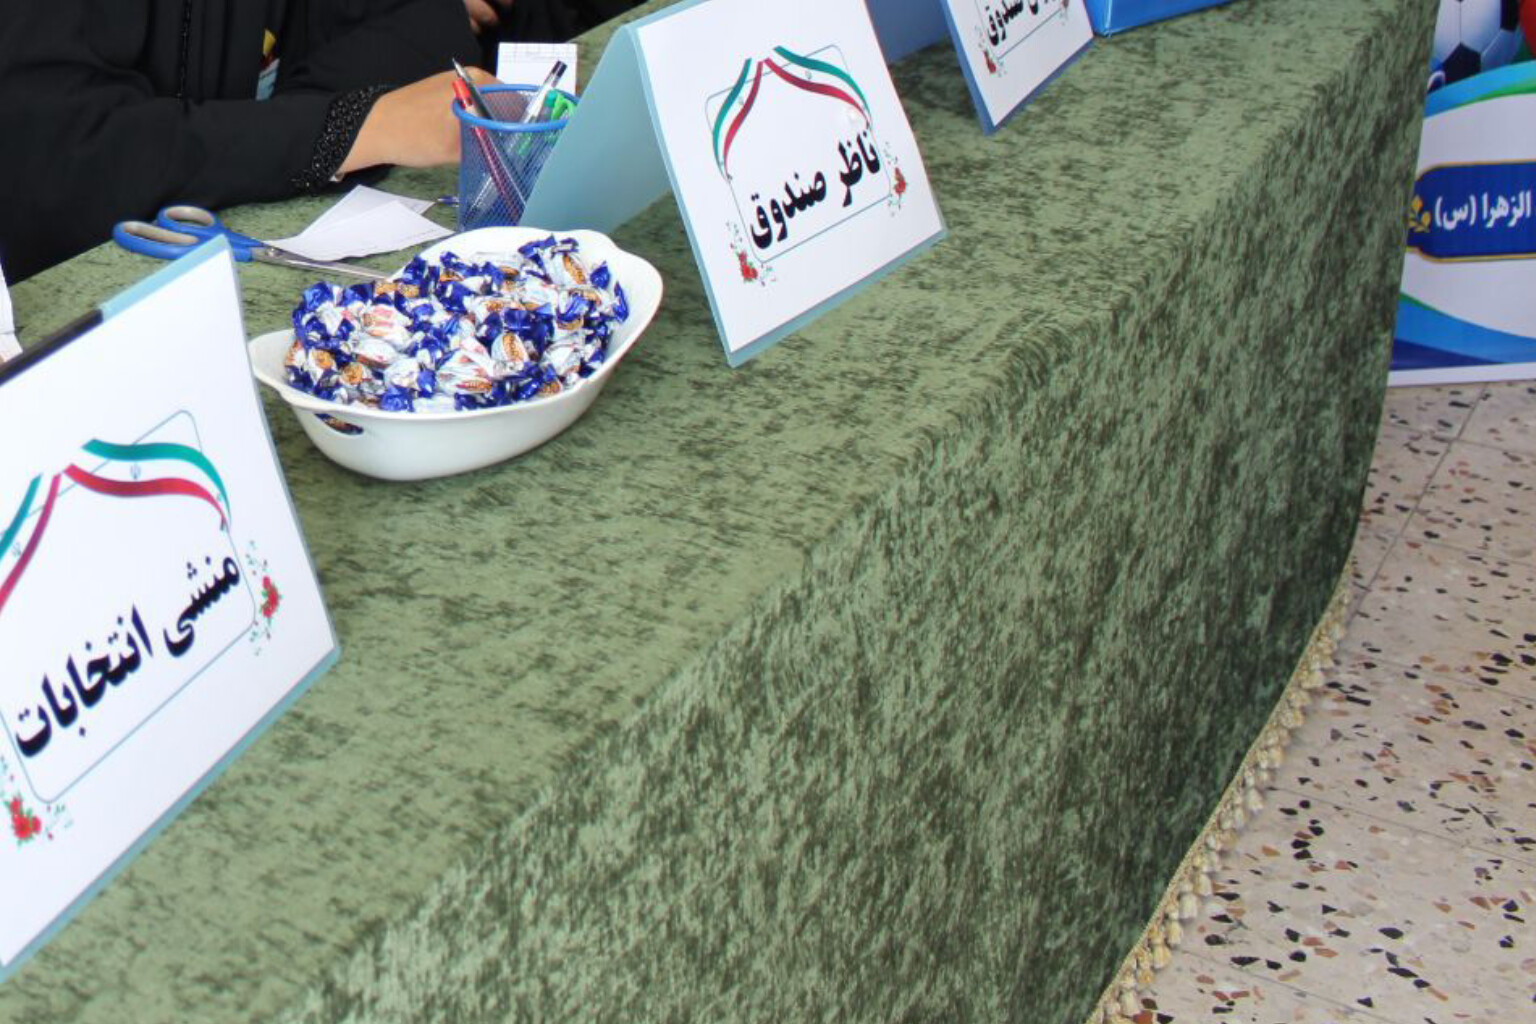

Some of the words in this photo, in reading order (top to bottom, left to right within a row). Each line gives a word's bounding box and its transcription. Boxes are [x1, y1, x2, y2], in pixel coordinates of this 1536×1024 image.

[838, 131, 880, 208] ناظر
[750, 169, 827, 249] صندوق
[1434, 194, 1477, 230] (س)
[1482, 190, 1531, 228] الزهرا
[164, 556, 240, 658] منشی
[16, 604, 154, 758] انتخابات
